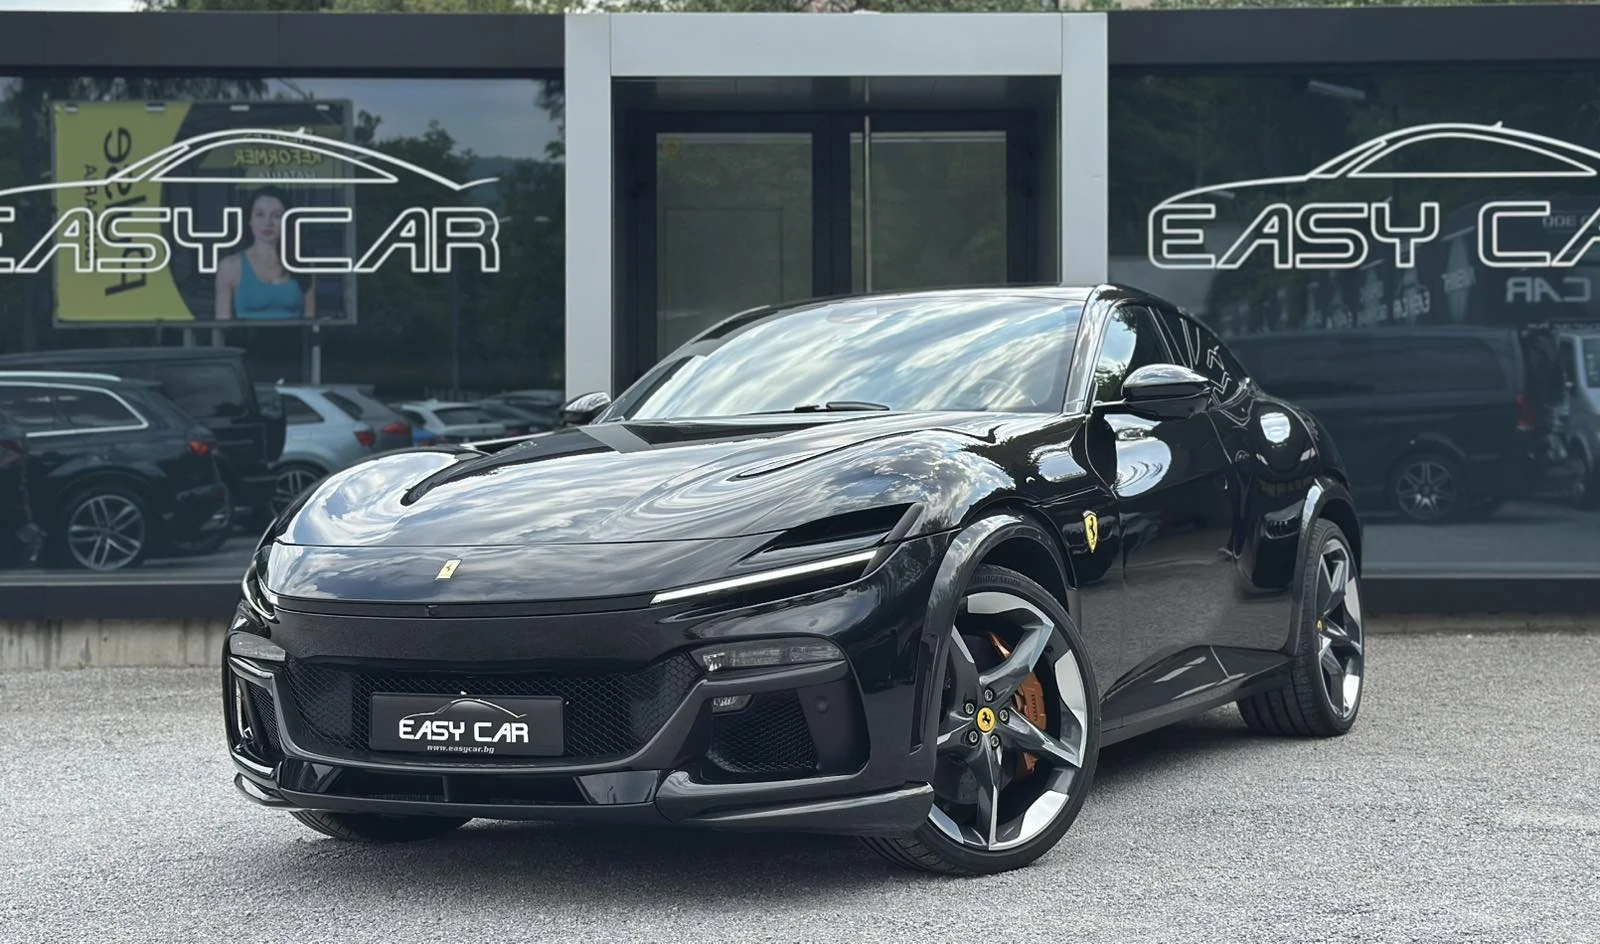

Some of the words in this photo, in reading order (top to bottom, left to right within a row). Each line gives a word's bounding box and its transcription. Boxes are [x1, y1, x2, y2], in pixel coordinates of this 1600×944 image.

[0, 207, 243, 273] ASY
[281, 207, 500, 273] CAR
[1148, 201, 1440, 269] EASY
[399, 720, 465, 741] EASY
[474, 721, 529, 743] CAR
[427, 744, 494, 754] www.easycar.bg
